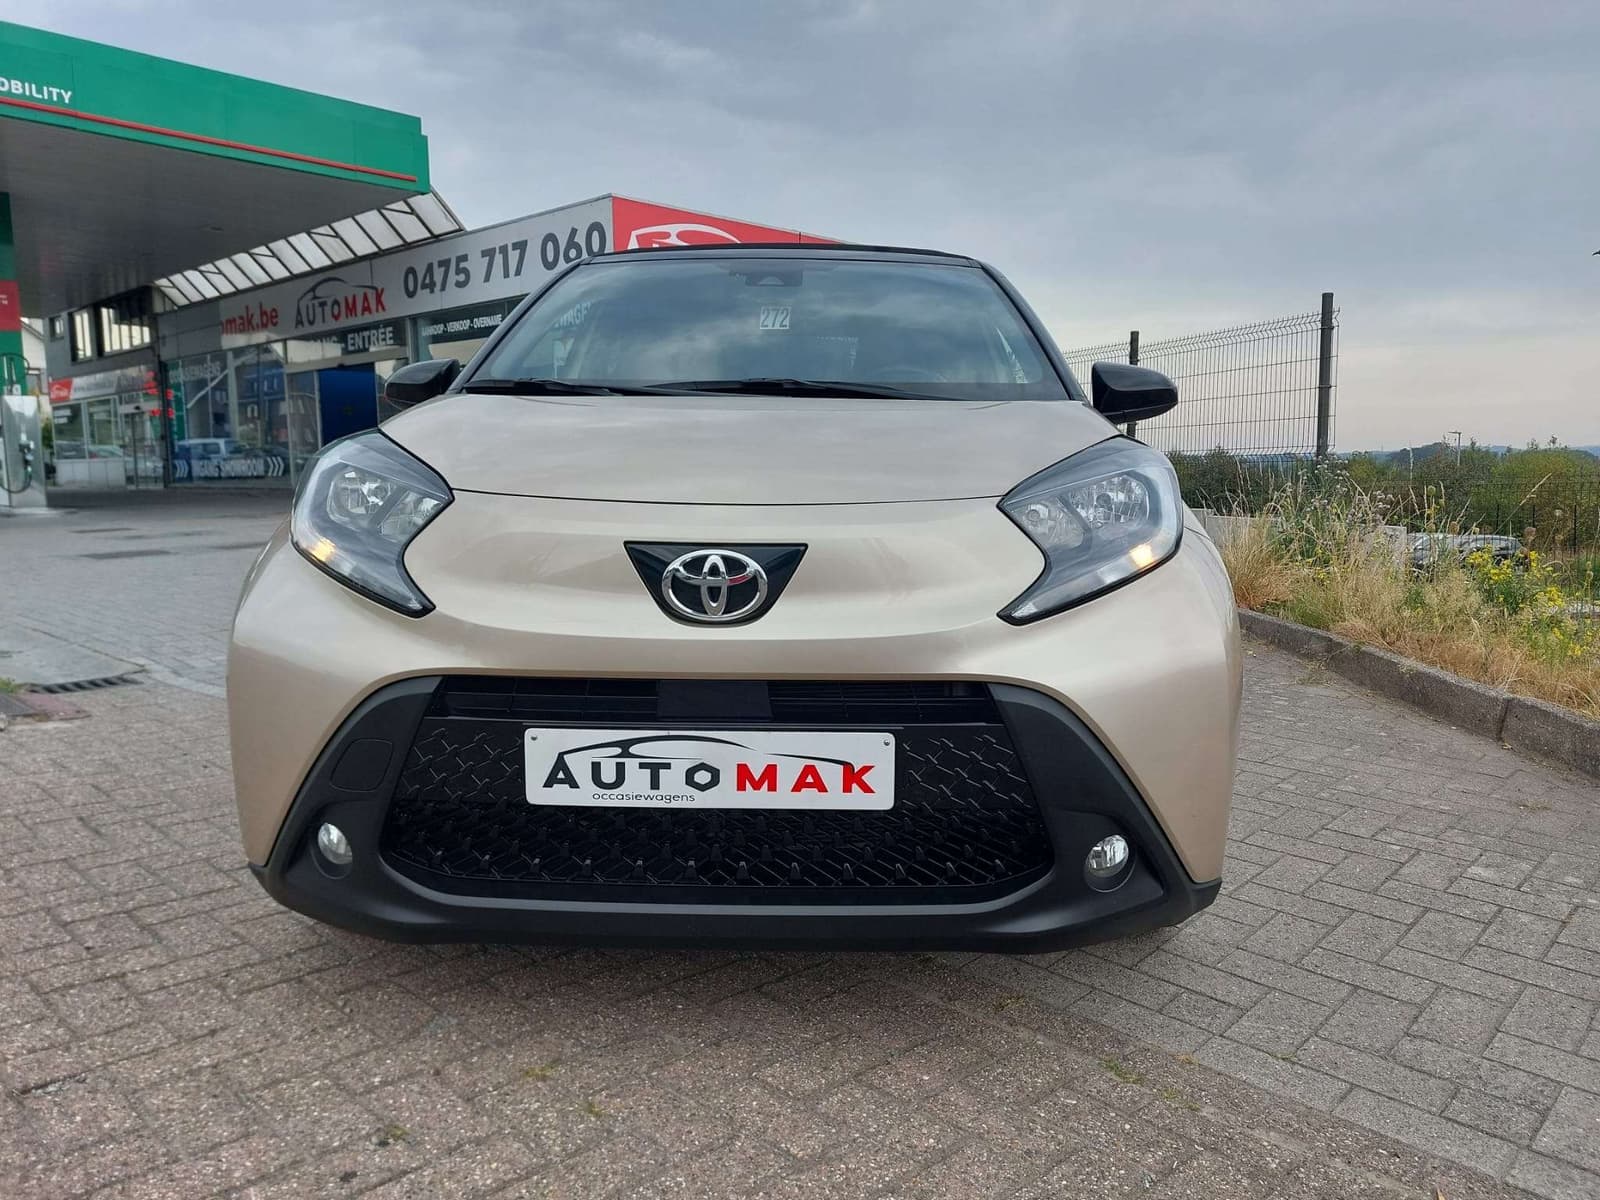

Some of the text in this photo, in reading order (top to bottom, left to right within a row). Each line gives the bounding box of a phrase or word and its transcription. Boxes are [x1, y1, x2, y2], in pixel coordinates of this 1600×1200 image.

[404, 221, 606, 298] 0475 717 060
[295, 287, 387, 329] AUTOMAK
[760, 307, 789, 328] 272
[347, 324, 394, 351] ENTRÉE
[542, 752, 876, 794] AUTOMAK
[591, 791, 696, 804] occasiewagens
